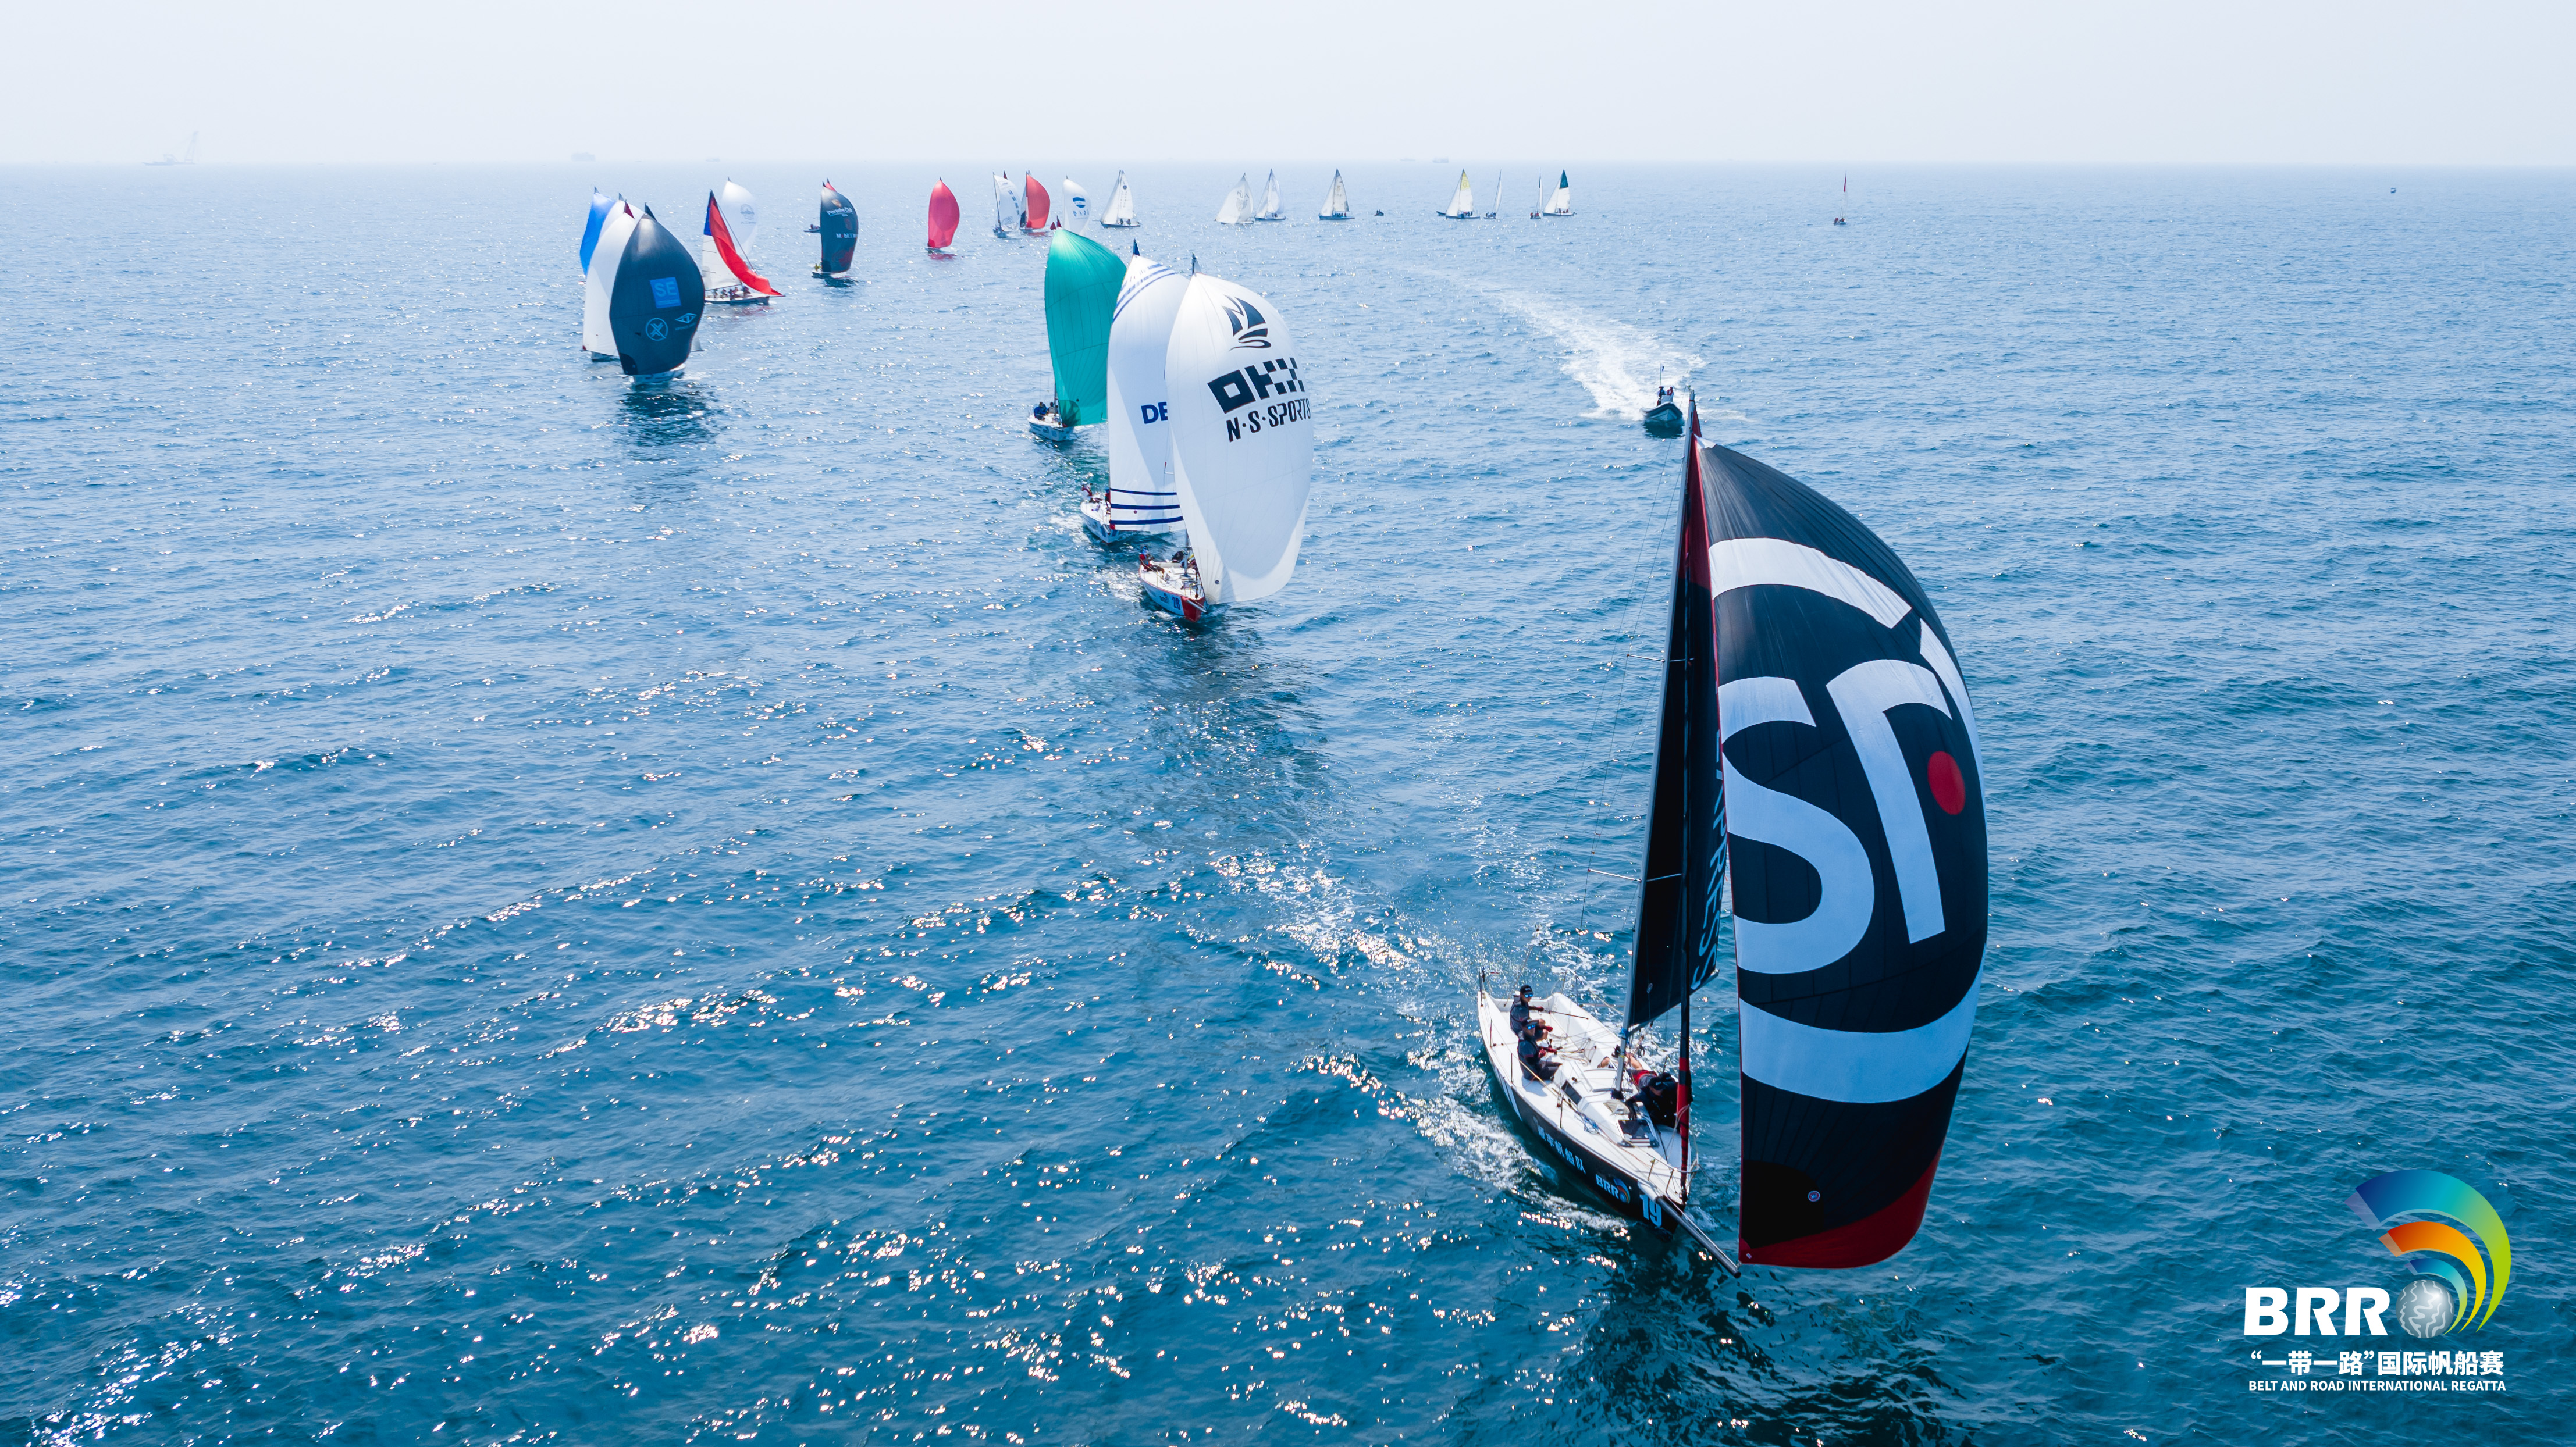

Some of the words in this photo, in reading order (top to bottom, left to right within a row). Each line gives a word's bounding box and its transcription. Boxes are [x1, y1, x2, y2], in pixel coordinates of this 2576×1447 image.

[654, 281, 677, 297] SE
[1596, 1174, 1619, 1199] BRR
[1639, 1193, 1662, 1228] 19
